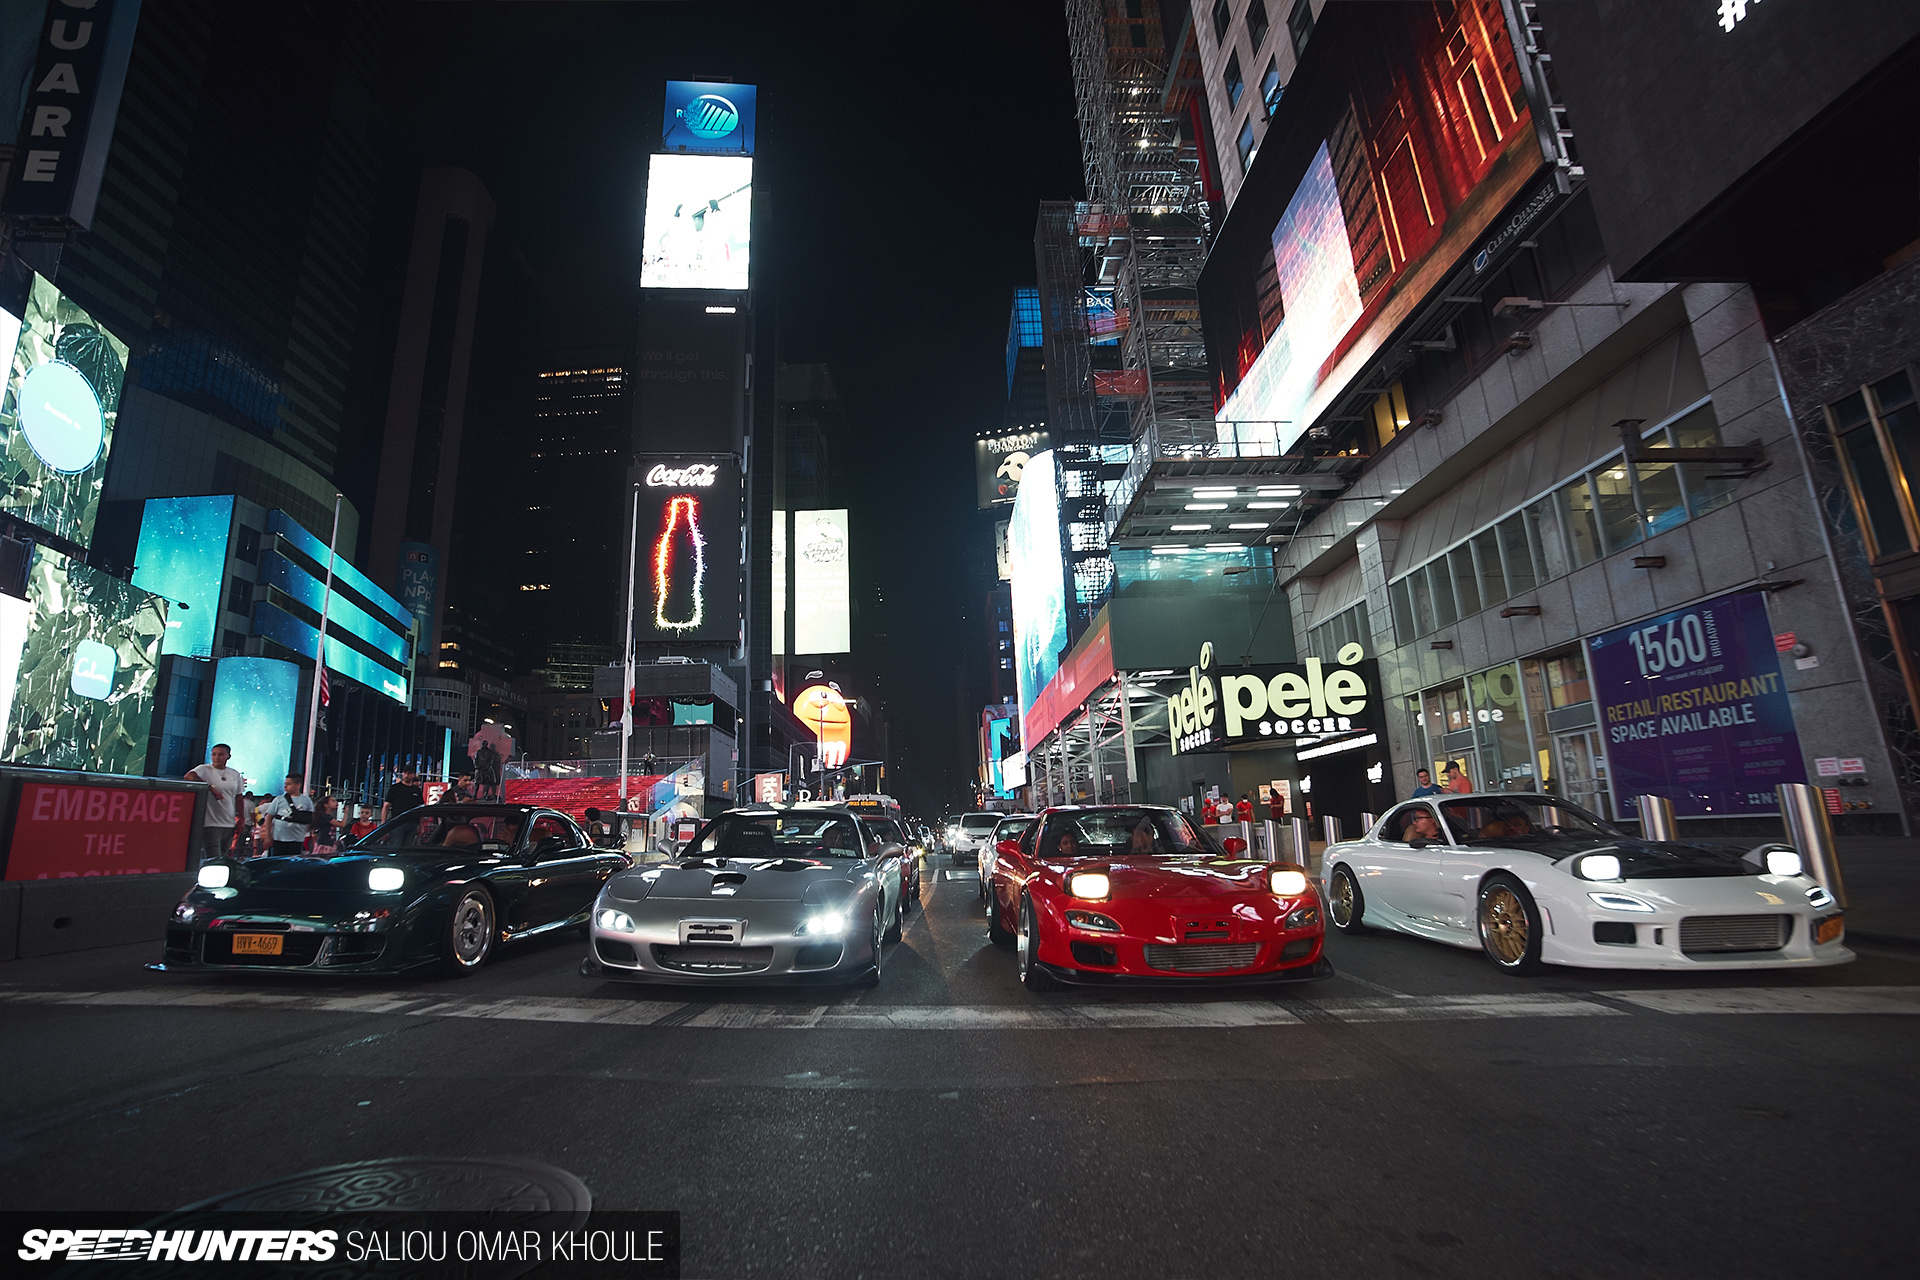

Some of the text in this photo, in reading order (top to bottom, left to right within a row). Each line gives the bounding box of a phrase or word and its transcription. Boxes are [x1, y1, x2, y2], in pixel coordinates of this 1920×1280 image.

[22, 0, 98, 183] UARE
[1086, 297, 1113, 307] BAR
[641, 350, 701, 364] We'll get
[640, 369, 697, 383] through
[986, 436, 1038, 451] PHANTOM
[1628, 609, 1723, 676] 1560 BROADWAY
[1167, 641, 1217, 757] pelé
[1221, 641, 1367, 737] pelé
[1607, 672, 1779, 723] RETAIL/RESTAURANT
[1258, 717, 1352, 735] SOCCER
[1611, 703, 1757, 744] SPACE AVAILABLE
[1179, 728, 1213, 753] SOCCER
[32, 788, 184, 823] EMBRACE
[84, 833, 126, 856] THE
